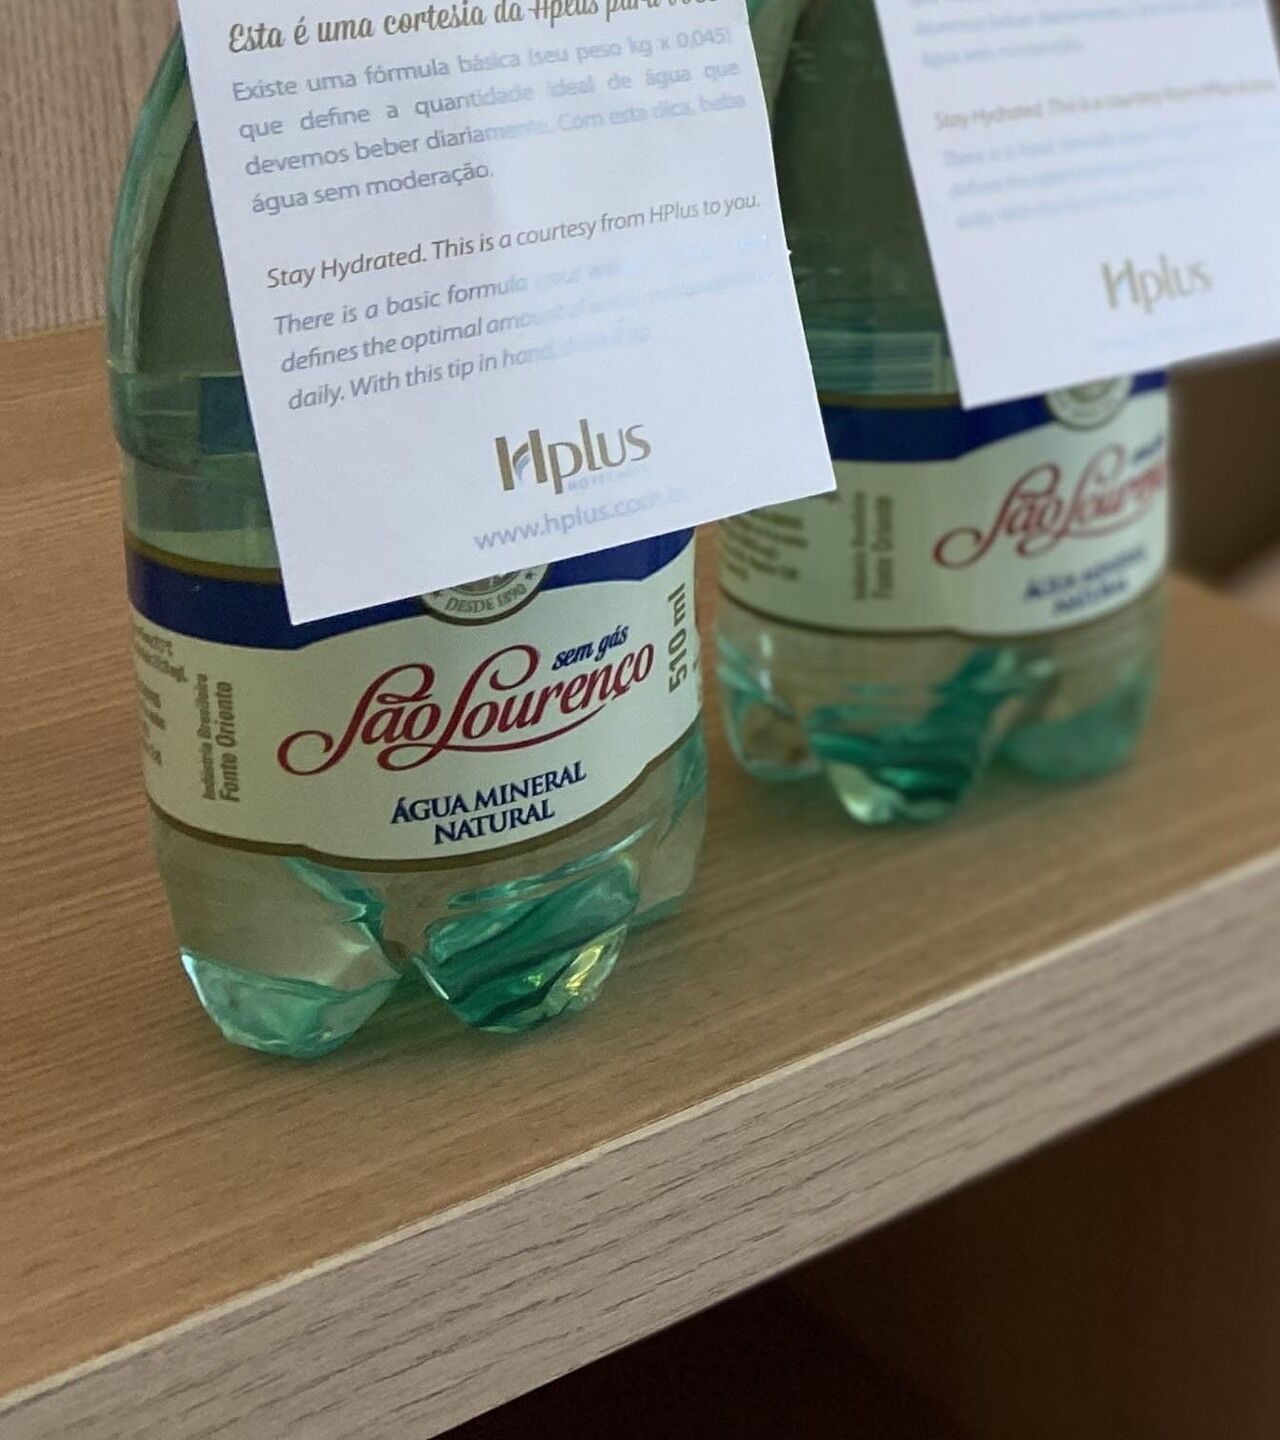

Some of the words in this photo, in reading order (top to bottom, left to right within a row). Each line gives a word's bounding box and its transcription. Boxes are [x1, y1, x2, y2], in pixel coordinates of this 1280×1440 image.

[229, 23, 285, 53] Esta
[293, 16, 311, 46] é
[317, 17, 375, 43] uma
[383, 0, 487, 35] cortesia
[232, 79, 298, 102] Existe
[306, 73, 357, 93] uma
[365, 59, 450, 86] fórmula
[457, 50, 521, 74] básica
[576, 42, 622, 65] peso
[627, 35, 653, 58] kg
[659, 37, 670, 51] x
[676, 26, 732, 51] 0,045)
[238, 121, 284, 143] que
[300, 107, 370, 131] define
[386, 104, 399, 120] a
[414, 84, 534, 119] quantidade
[546, 74, 596, 98] ideal
[607, 71, 631, 91] de
[645, 66, 693, 89] água
[703, 61, 741, 81] que
[244, 149, 349, 176] devemos
[354, 136, 419, 161] beber
[557, 111, 605, 132] Com
[251, 191, 309, 217] água
[313, 184, 361, 205] sem
[366, 160, 495, 197] moderação.
[266, 266, 316, 290] Stay
[320, 243, 428, 283] Hydrated.
[431, 235, 475, 260] This
[479, 233, 495, 253] is
[499, 233, 512, 249] a
[516, 219, 597, 246] courtesy
[600, 211, 646, 234] from
[649, 201, 700, 226] HPlus
[702, 199, 722, 216] to
[723, 193, 762, 218] you.
[273, 312, 335, 336] There
[341, 305, 358, 324] is
[364, 304, 379, 321] a
[385, 291, 441, 317] basic
[446, 274, 528, 307] formula
[1099, 250, 1215, 317] Hplus
[279, 344, 359, 374] defines
[362, 336, 398, 358] the
[400, 316, 483, 353] optimal
[287, 383, 345, 411] daily.
[350, 373, 401, 398] With
[405, 365, 444, 388] this
[446, 357, 475, 381] tip
[479, 352, 499, 370] in
[494, 417, 653, 495] Hplus
[445, 597, 495, 614] DESDE
[667, 582, 686, 628] ml
[551, 638, 596, 672] sem
[594, 623, 631, 661] gás
[668, 627, 688, 695] 510
[213, 680, 240, 749] Oriente
[277, 663, 441, 777] São
[377, 643, 656, 773] Lourenço
[218, 751, 241, 803] Fonte
[389, 793, 473, 826] ÁGUA
[473, 760, 588, 812] MINERAL
[433, 799, 557, 846] NATURAL
